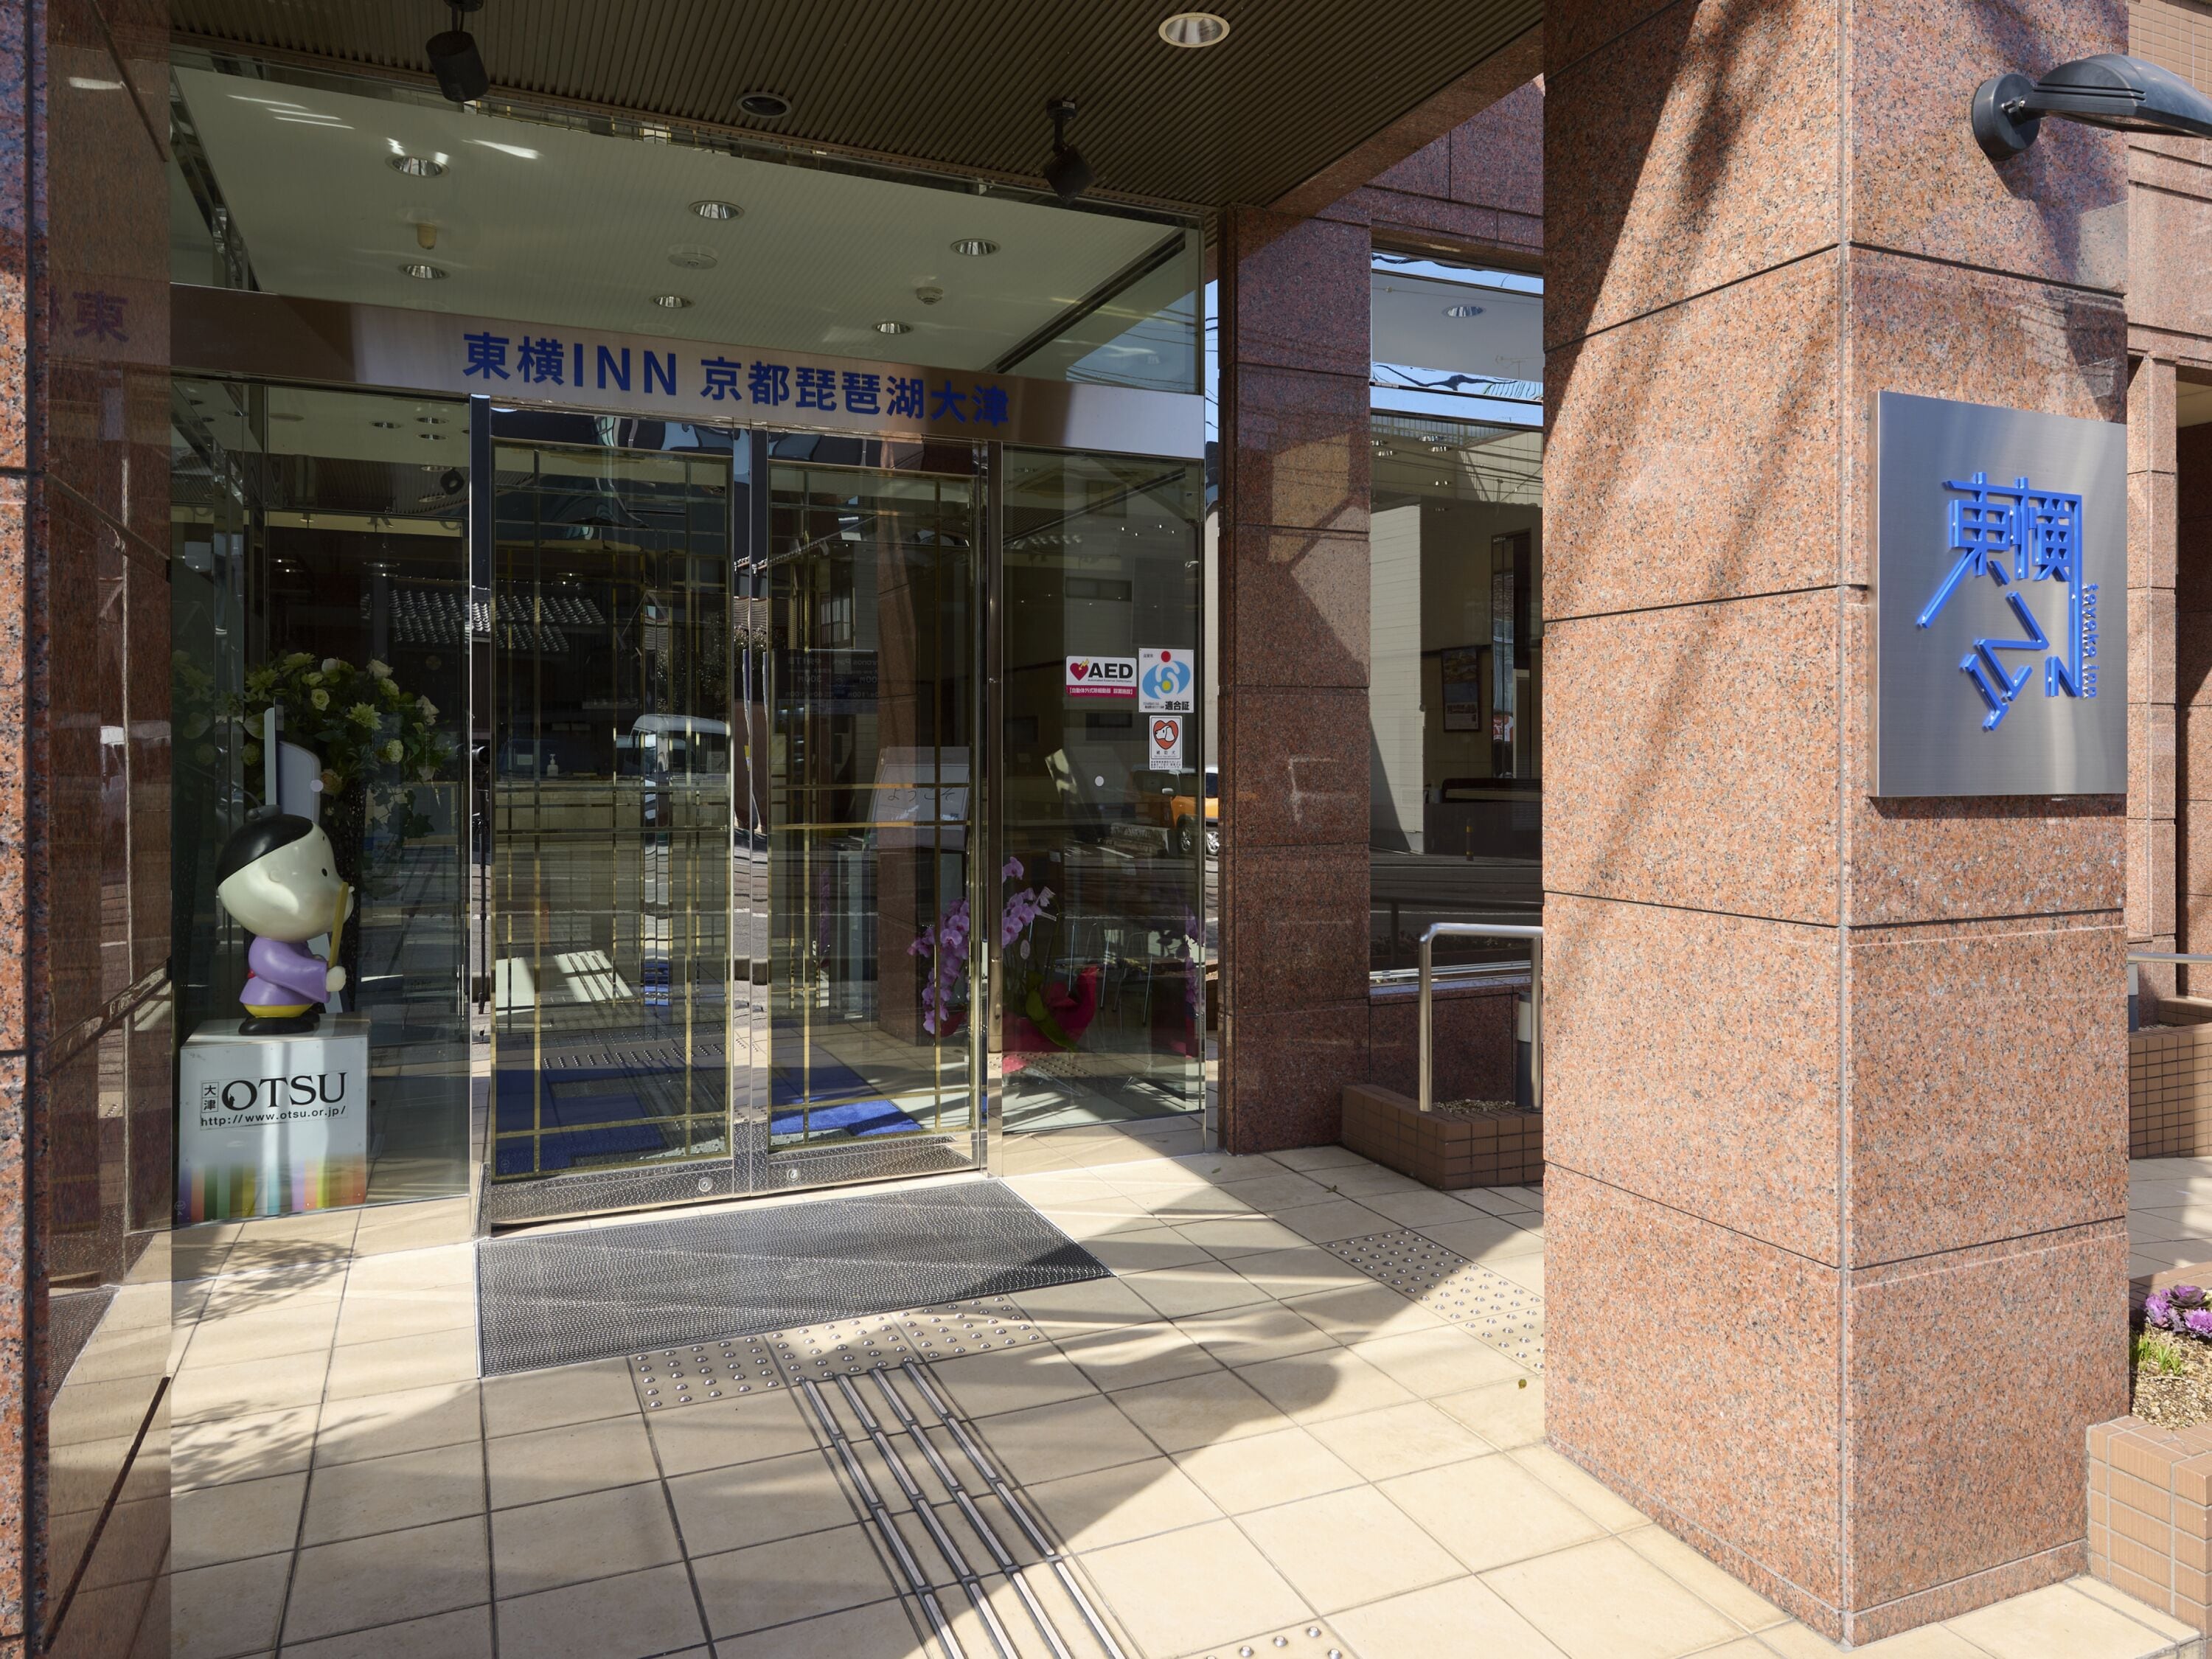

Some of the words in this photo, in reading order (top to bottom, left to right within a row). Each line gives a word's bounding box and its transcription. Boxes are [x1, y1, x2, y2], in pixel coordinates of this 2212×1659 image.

[463, 332, 677, 396] 東横INN
[700, 356, 1009, 428] 京都琵琶湖大津
[2086, 583, 2100, 658] toyoko
[1088, 662, 1133, 679] AED
[2086, 664, 2100, 699] inn
[1165, 700, 1189, 711] 適合証
[203, 1084, 218, 1111] 大津
[221, 1072, 347, 1111] OTSU
[201, 1105, 346, 1127] http://www.otsu.or.jp/
